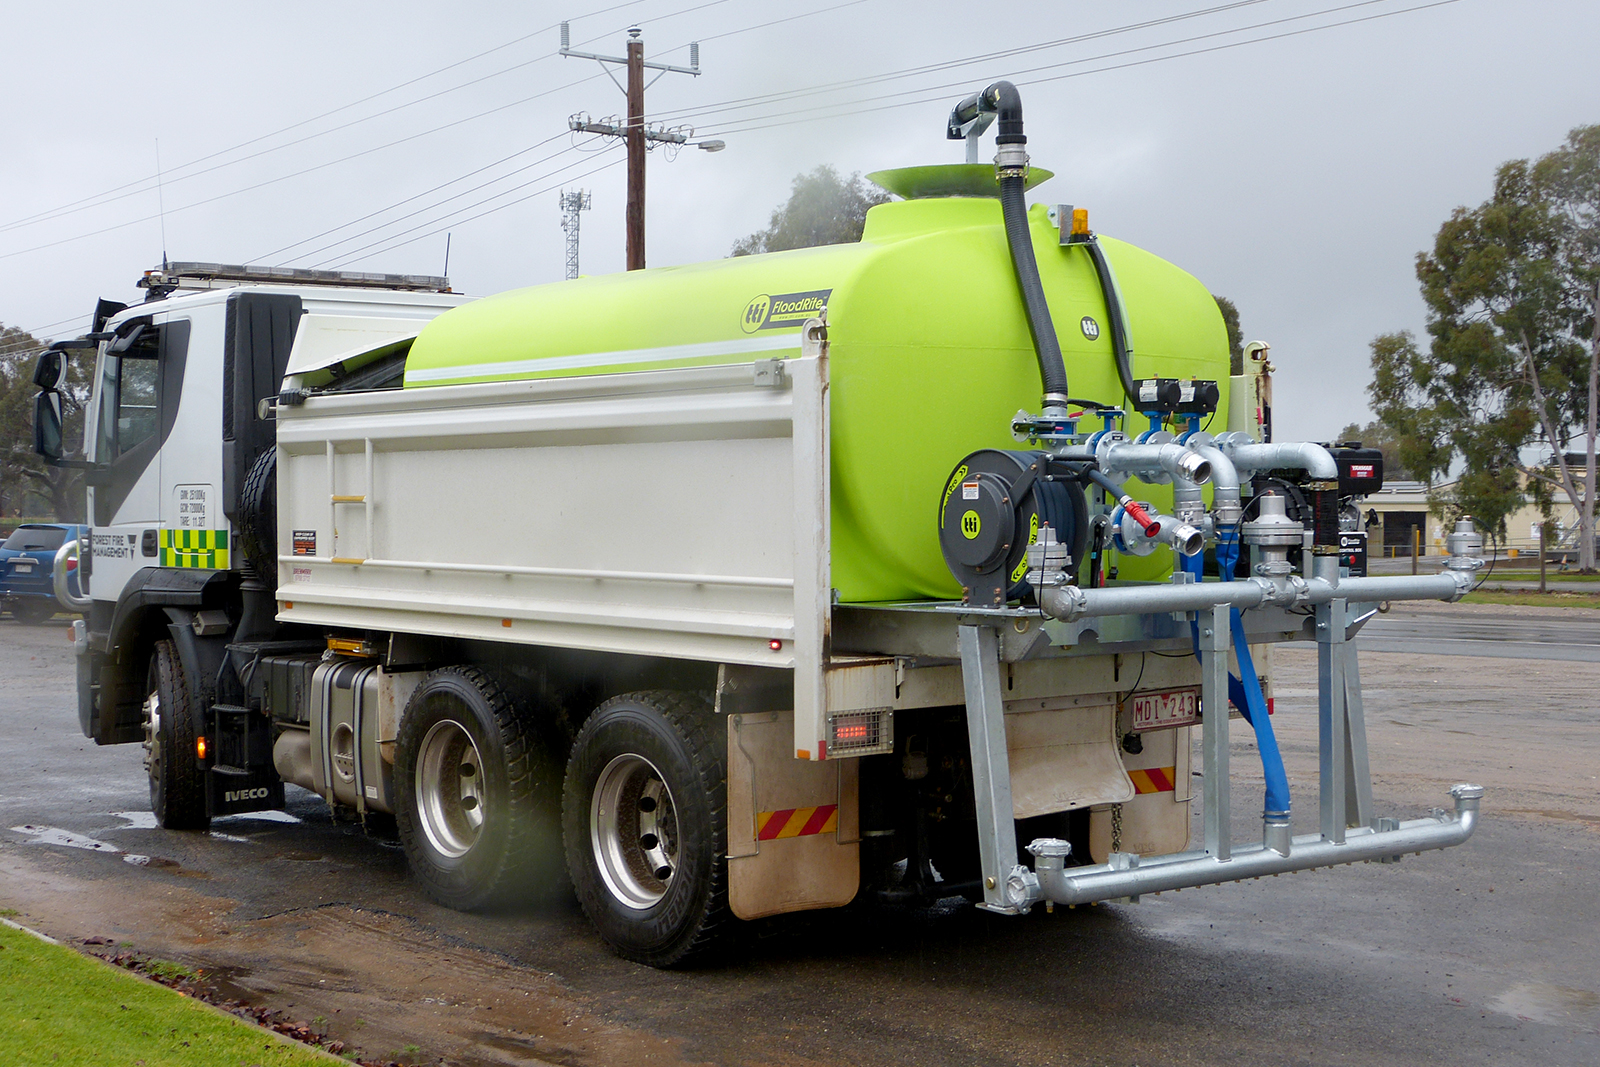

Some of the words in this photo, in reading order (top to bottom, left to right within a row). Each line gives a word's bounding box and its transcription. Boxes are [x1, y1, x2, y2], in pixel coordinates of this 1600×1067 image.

[772, 297, 823, 314] FloodRite
[92, 534, 111, 546] FOREST
[112, 535, 124, 546] FIRE
[92, 547, 129, 559] MANAGEMENT
[1170, 695, 1194, 718] 243
[225, 787, 269, 802] IVECO
